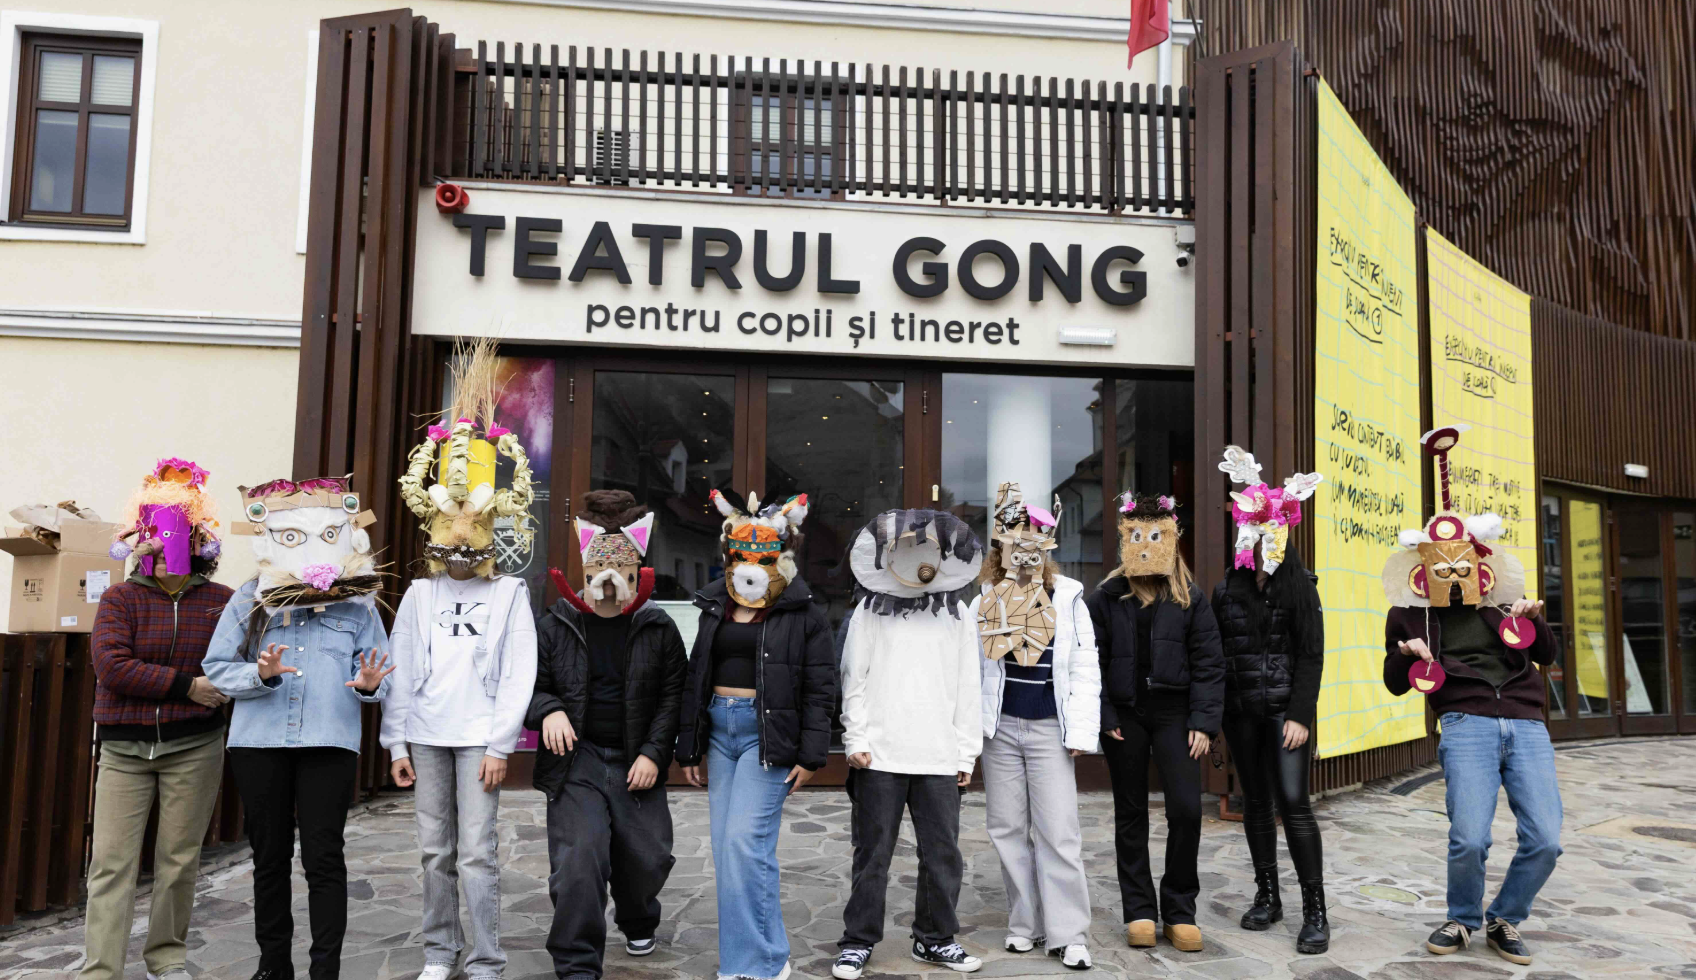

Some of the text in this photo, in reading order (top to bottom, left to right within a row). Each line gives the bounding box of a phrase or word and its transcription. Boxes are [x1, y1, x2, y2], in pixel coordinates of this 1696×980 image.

[452, 213, 1148, 308] TEATRUL GONG
[586, 302, 1020, 349] pentru copii și tineret
